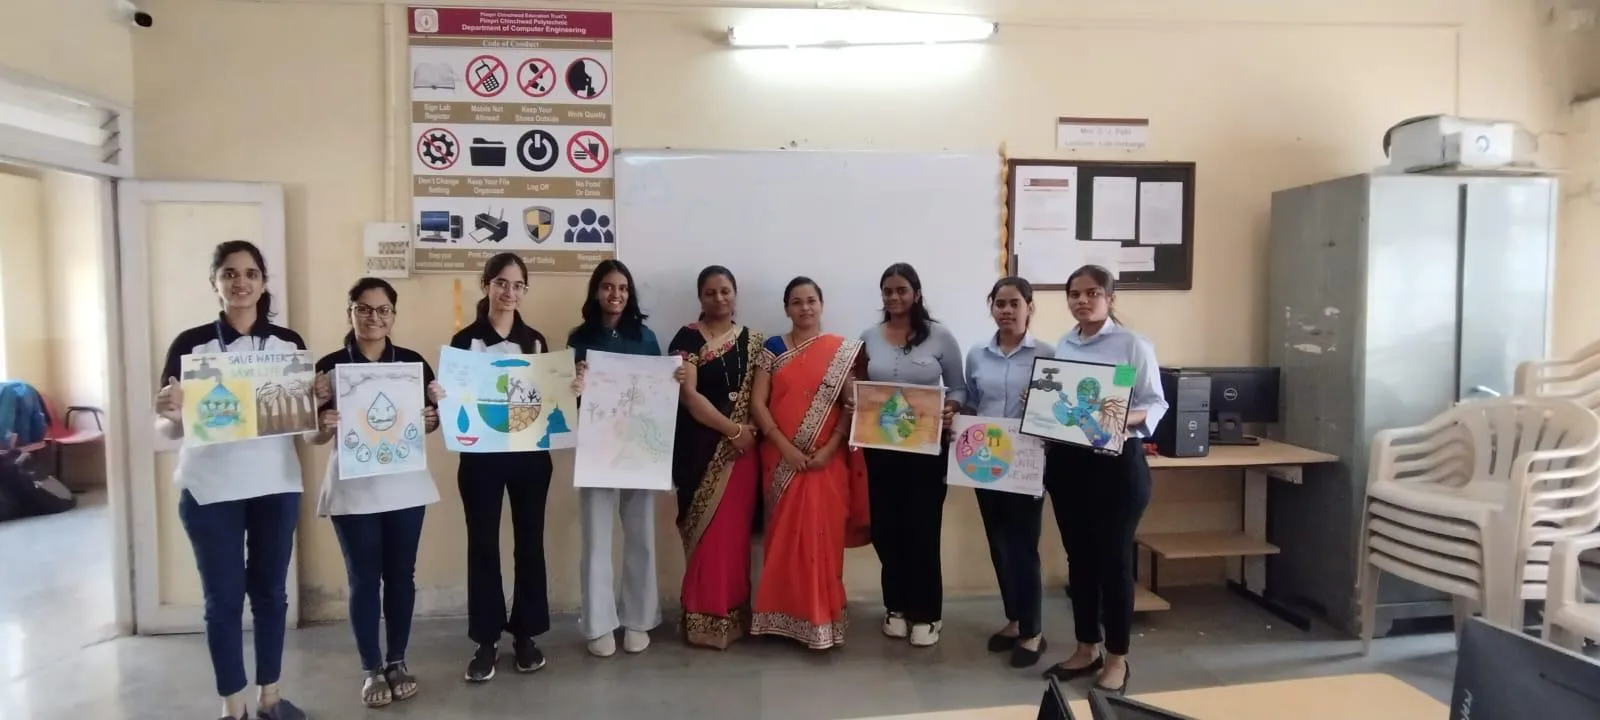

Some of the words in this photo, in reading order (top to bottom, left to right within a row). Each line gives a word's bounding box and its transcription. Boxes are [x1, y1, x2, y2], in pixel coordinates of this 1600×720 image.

[462, 24, 501, 32] Department
[511, 25, 544, 33] Computer
[546, 26, 587, 35] Engineering
[521, 105, 537, 114] Keep
[538, 106, 552, 114] Your
[526, 183, 539, 191] Log
[540, 183, 550, 191] Off
[228, 354, 254, 365] SAVE
[256, 353, 288, 363] WATER
